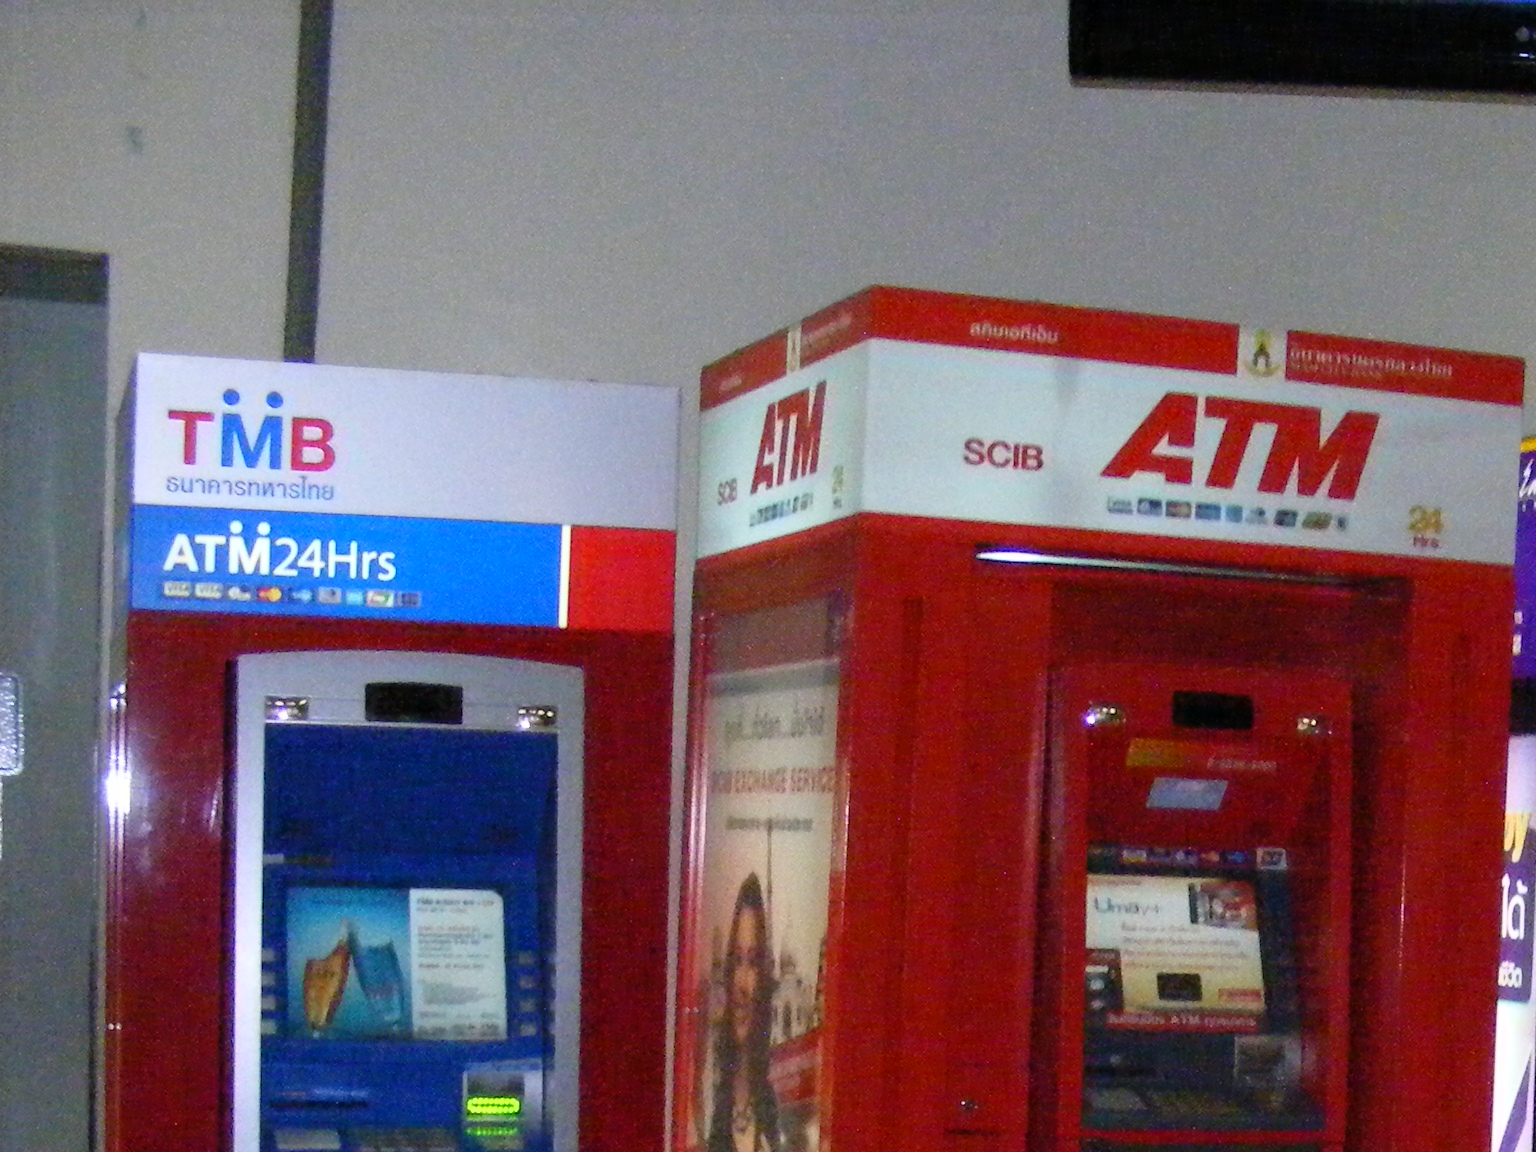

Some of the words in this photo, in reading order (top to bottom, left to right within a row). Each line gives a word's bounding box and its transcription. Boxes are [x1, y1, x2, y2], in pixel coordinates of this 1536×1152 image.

[168, 388, 336, 472] TMB
[751, 380, 827, 494] ATM
[962, 436, 1044, 472] SCIB
[1100, 391, 1381, 502] ATM
[166, 475, 335, 501] ธนาคารทหารไทย
